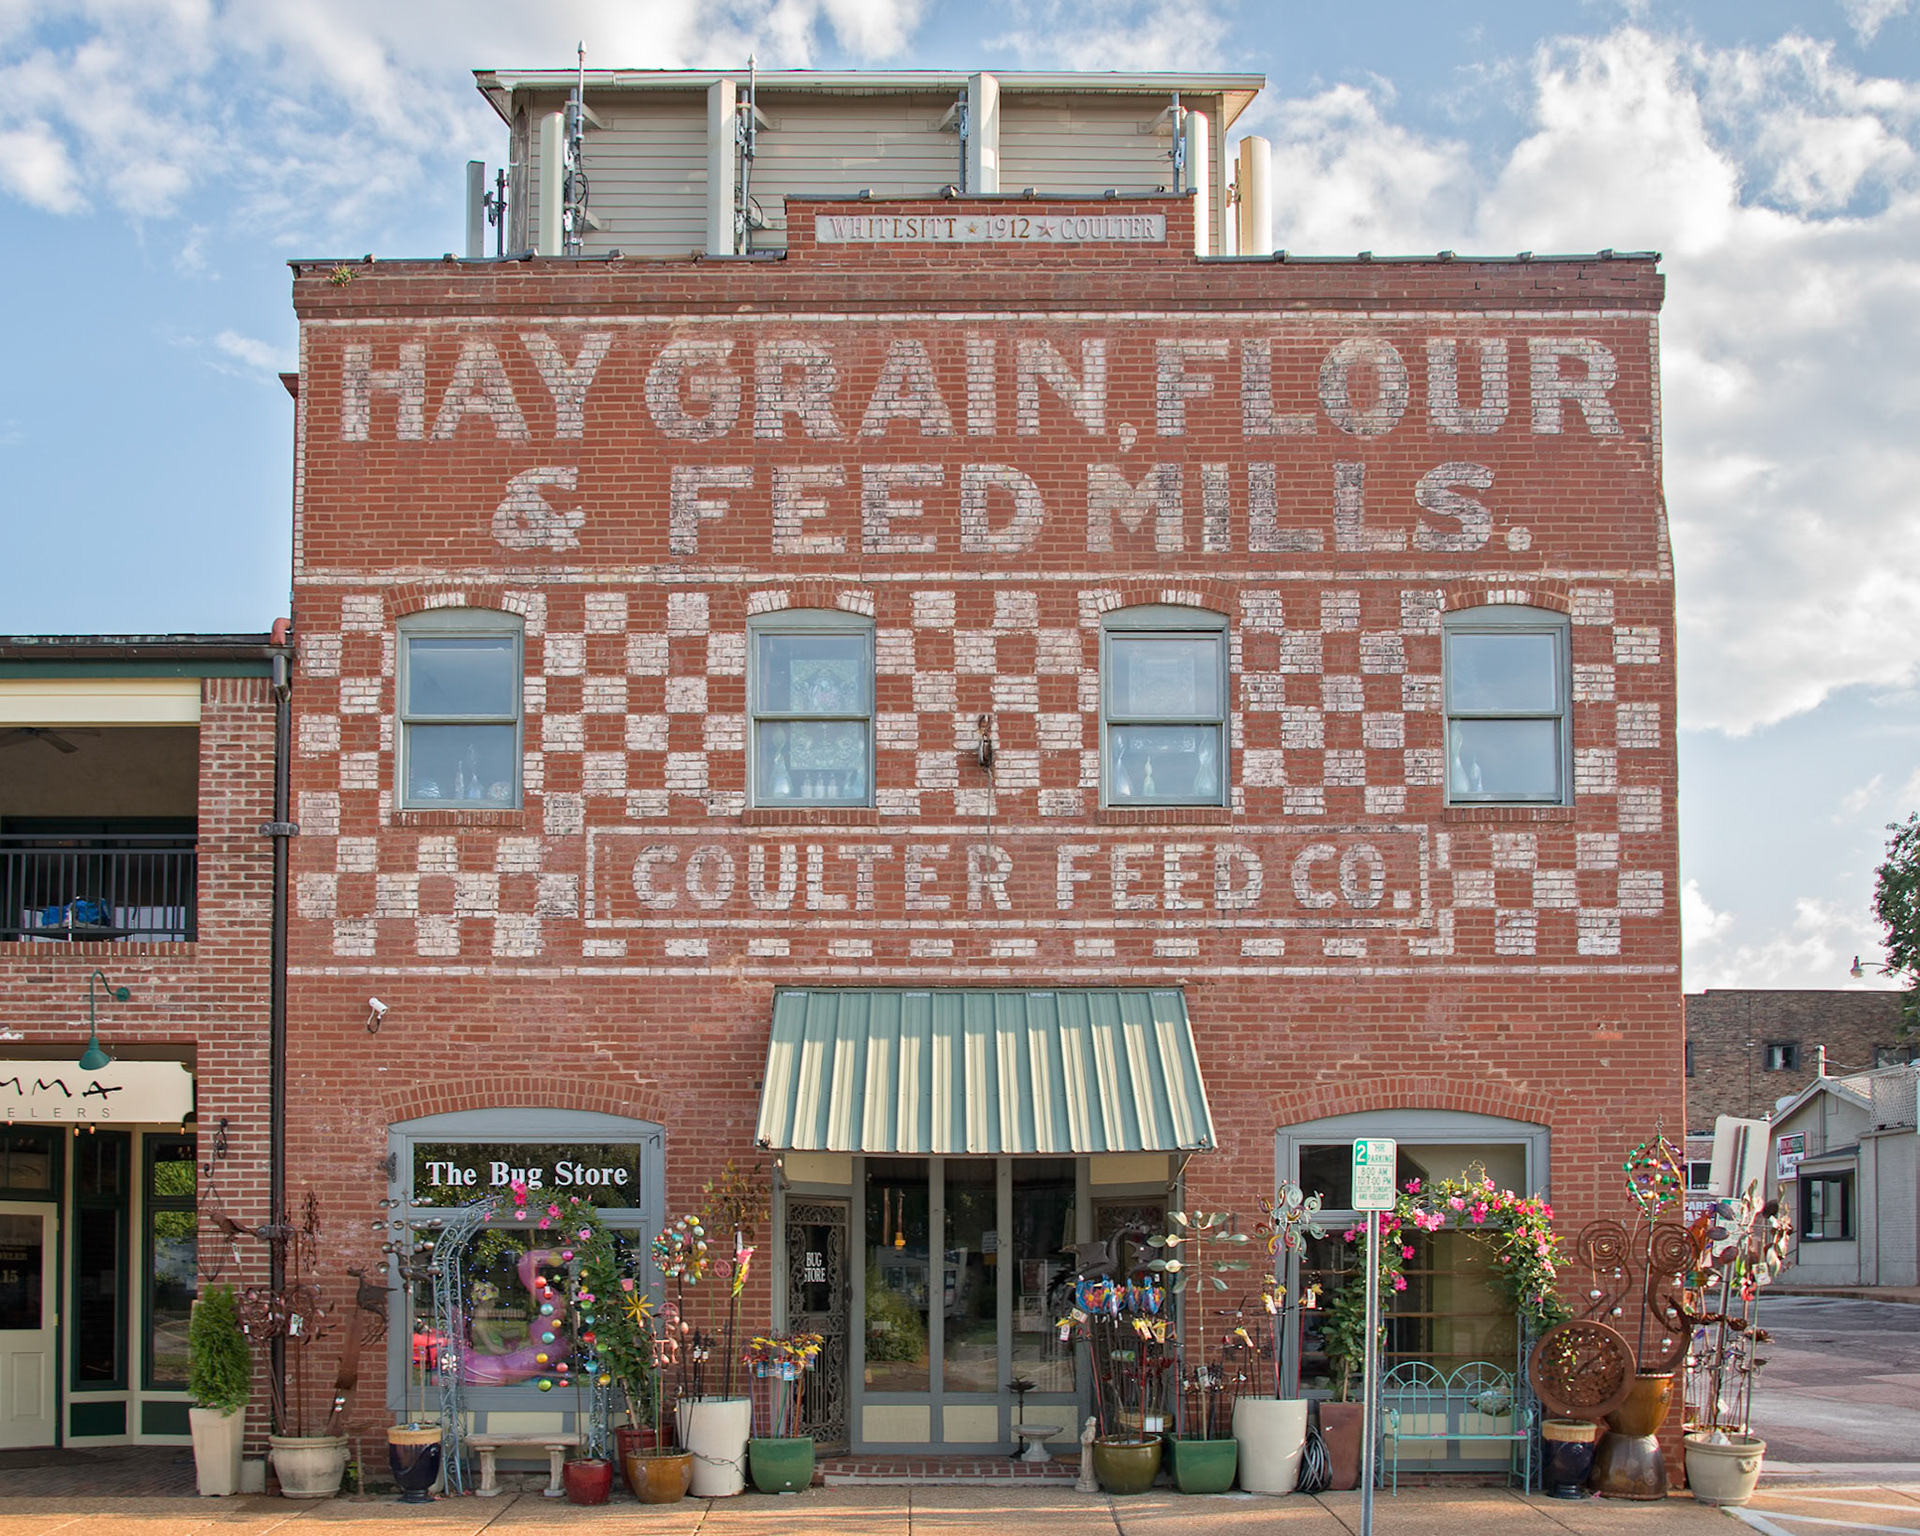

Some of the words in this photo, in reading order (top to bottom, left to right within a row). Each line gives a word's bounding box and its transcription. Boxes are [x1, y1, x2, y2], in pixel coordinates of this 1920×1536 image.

[829, 217, 957, 239] WHITESITT
[985, 217, 1030, 239] 1912
[1060, 217, 1156, 239] COULTER
[340, 331, 613, 443] HAY
[1155, 336, 1624, 441] FLOUR
[492, 465, 586, 554] &
[669, 462, 1046, 555] FEED
[1086, 461, 1533, 554] MILLS.
[632, 843, 1013, 911] COULTER
[1057, 842, 1264, 910] FEED
[1291, 842, 1413, 910] CO.
[7, 1107, 112, 1118] ELERS
[1356, 1144, 1366, 1162] 2
[1367, 1154, 1393, 1163] PARKING
[425, 1161, 477, 1187] The
[489, 1161, 543, 1191] Bug
[555, 1160, 629, 1187] Store
[806, 1252, 822, 1267] BUG
